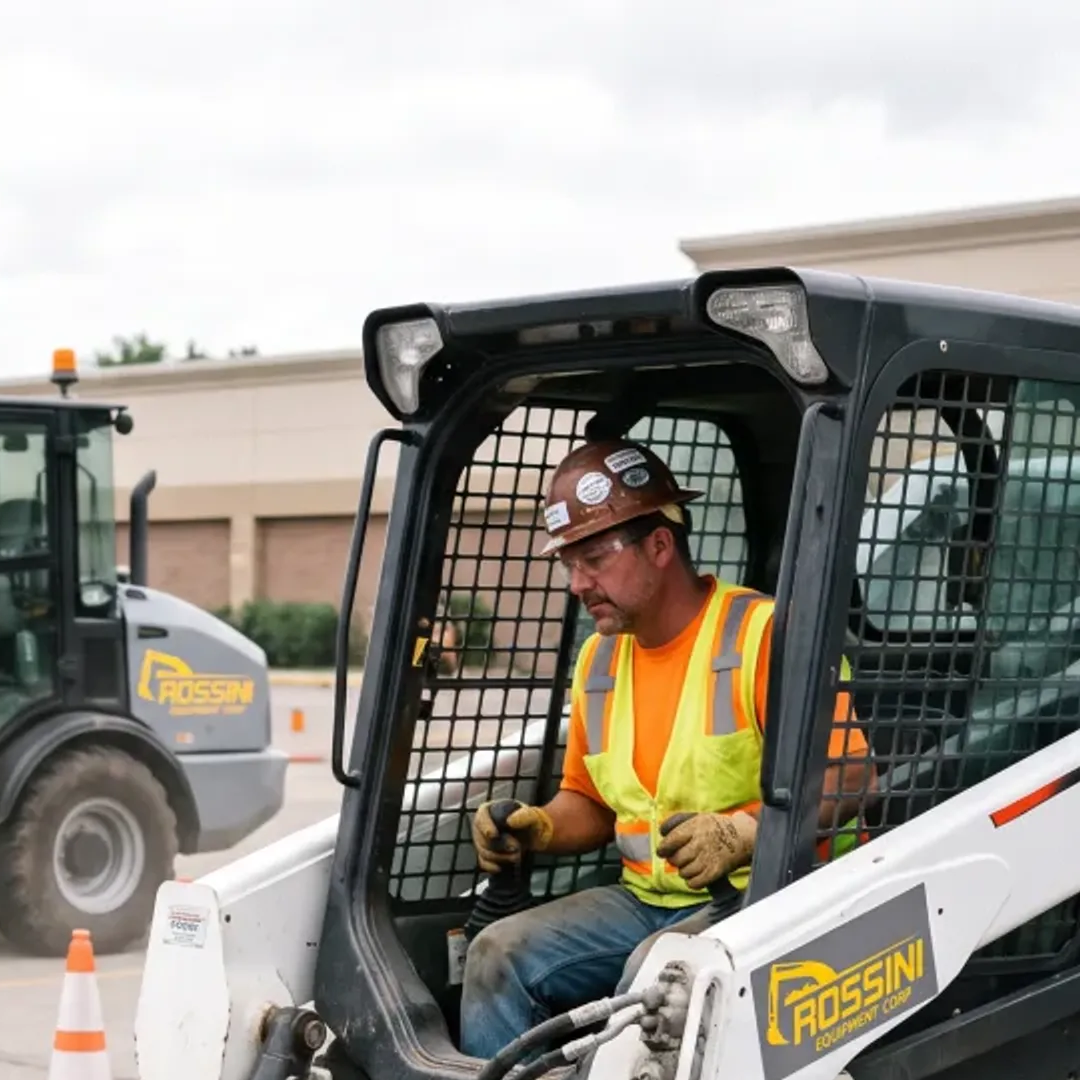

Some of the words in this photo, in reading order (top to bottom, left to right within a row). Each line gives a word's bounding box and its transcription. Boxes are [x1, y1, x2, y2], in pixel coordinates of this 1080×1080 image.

[793, 938, 924, 1045] ROSSINI
[815, 1006, 879, 1051] EQUIPMENT
[882, 986, 912, 1014] CORP
